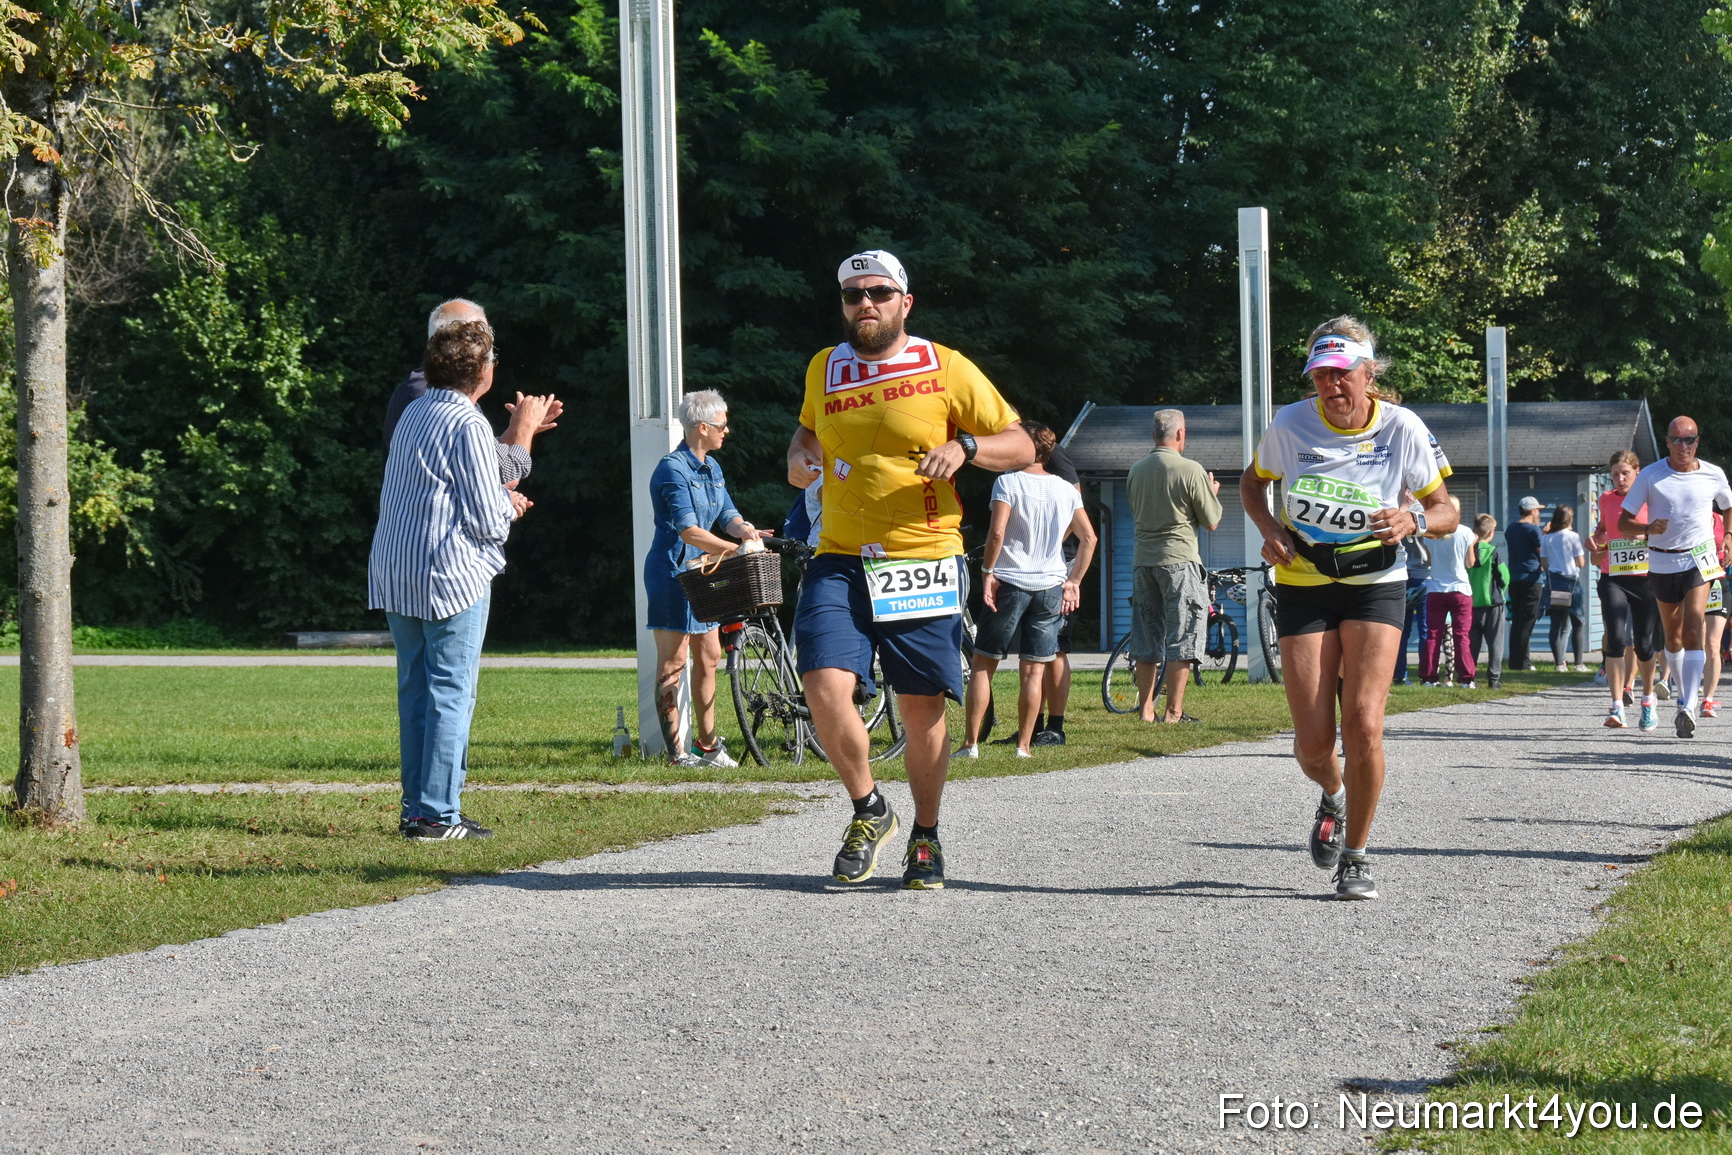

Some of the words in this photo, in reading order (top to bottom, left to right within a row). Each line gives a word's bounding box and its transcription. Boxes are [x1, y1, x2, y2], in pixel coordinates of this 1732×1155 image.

[824, 391, 876, 416] MAX
[882, 378, 946, 402] BÖGL
[1298, 453, 1325, 461] BOCK
[1357, 442, 1374, 453] 20
[1297, 479, 1371, 503] BOCK
[1296, 499, 1366, 531] 2749
[1613, 550, 1645, 563] 1346
[878, 567, 948, 594] 2394
[888, 595, 944, 611] THOMAS
